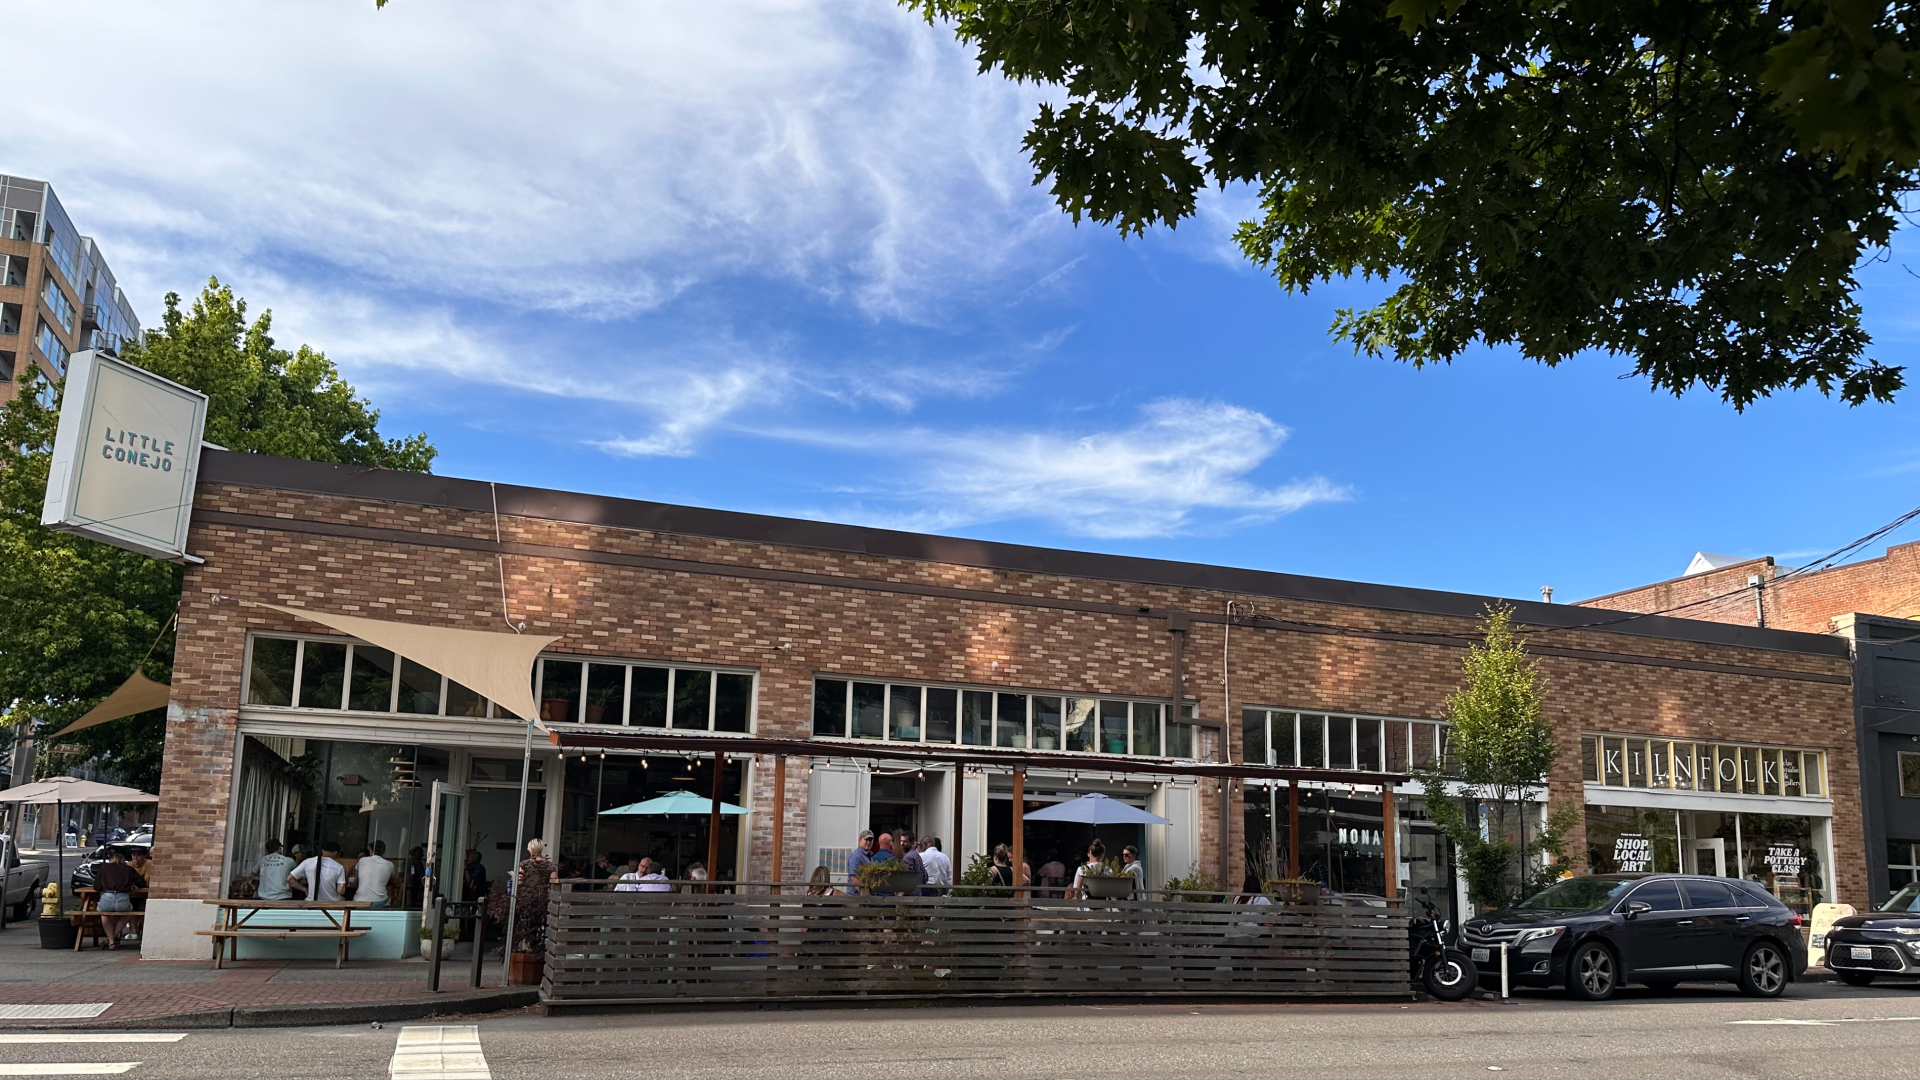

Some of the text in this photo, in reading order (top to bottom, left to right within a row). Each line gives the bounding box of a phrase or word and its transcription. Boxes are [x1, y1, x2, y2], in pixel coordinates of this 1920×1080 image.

[105, 426, 175, 456] LITTLE
[102, 444, 172, 472] CONEJO
[1605, 749, 1778, 784] KILNFOLK
[1338, 828, 1385, 846] NONA
[1615, 838, 1649, 850] SHOP
[1343, 850, 1385, 859] PIZZ
[1613, 849, 1651, 861] LOCAL
[1768, 847, 1800, 857] TAKE A
[1620, 860, 1646, 872] ART
[1763, 855, 1807, 866] POTTERY
[1771, 864, 1800, 874] CLASS
